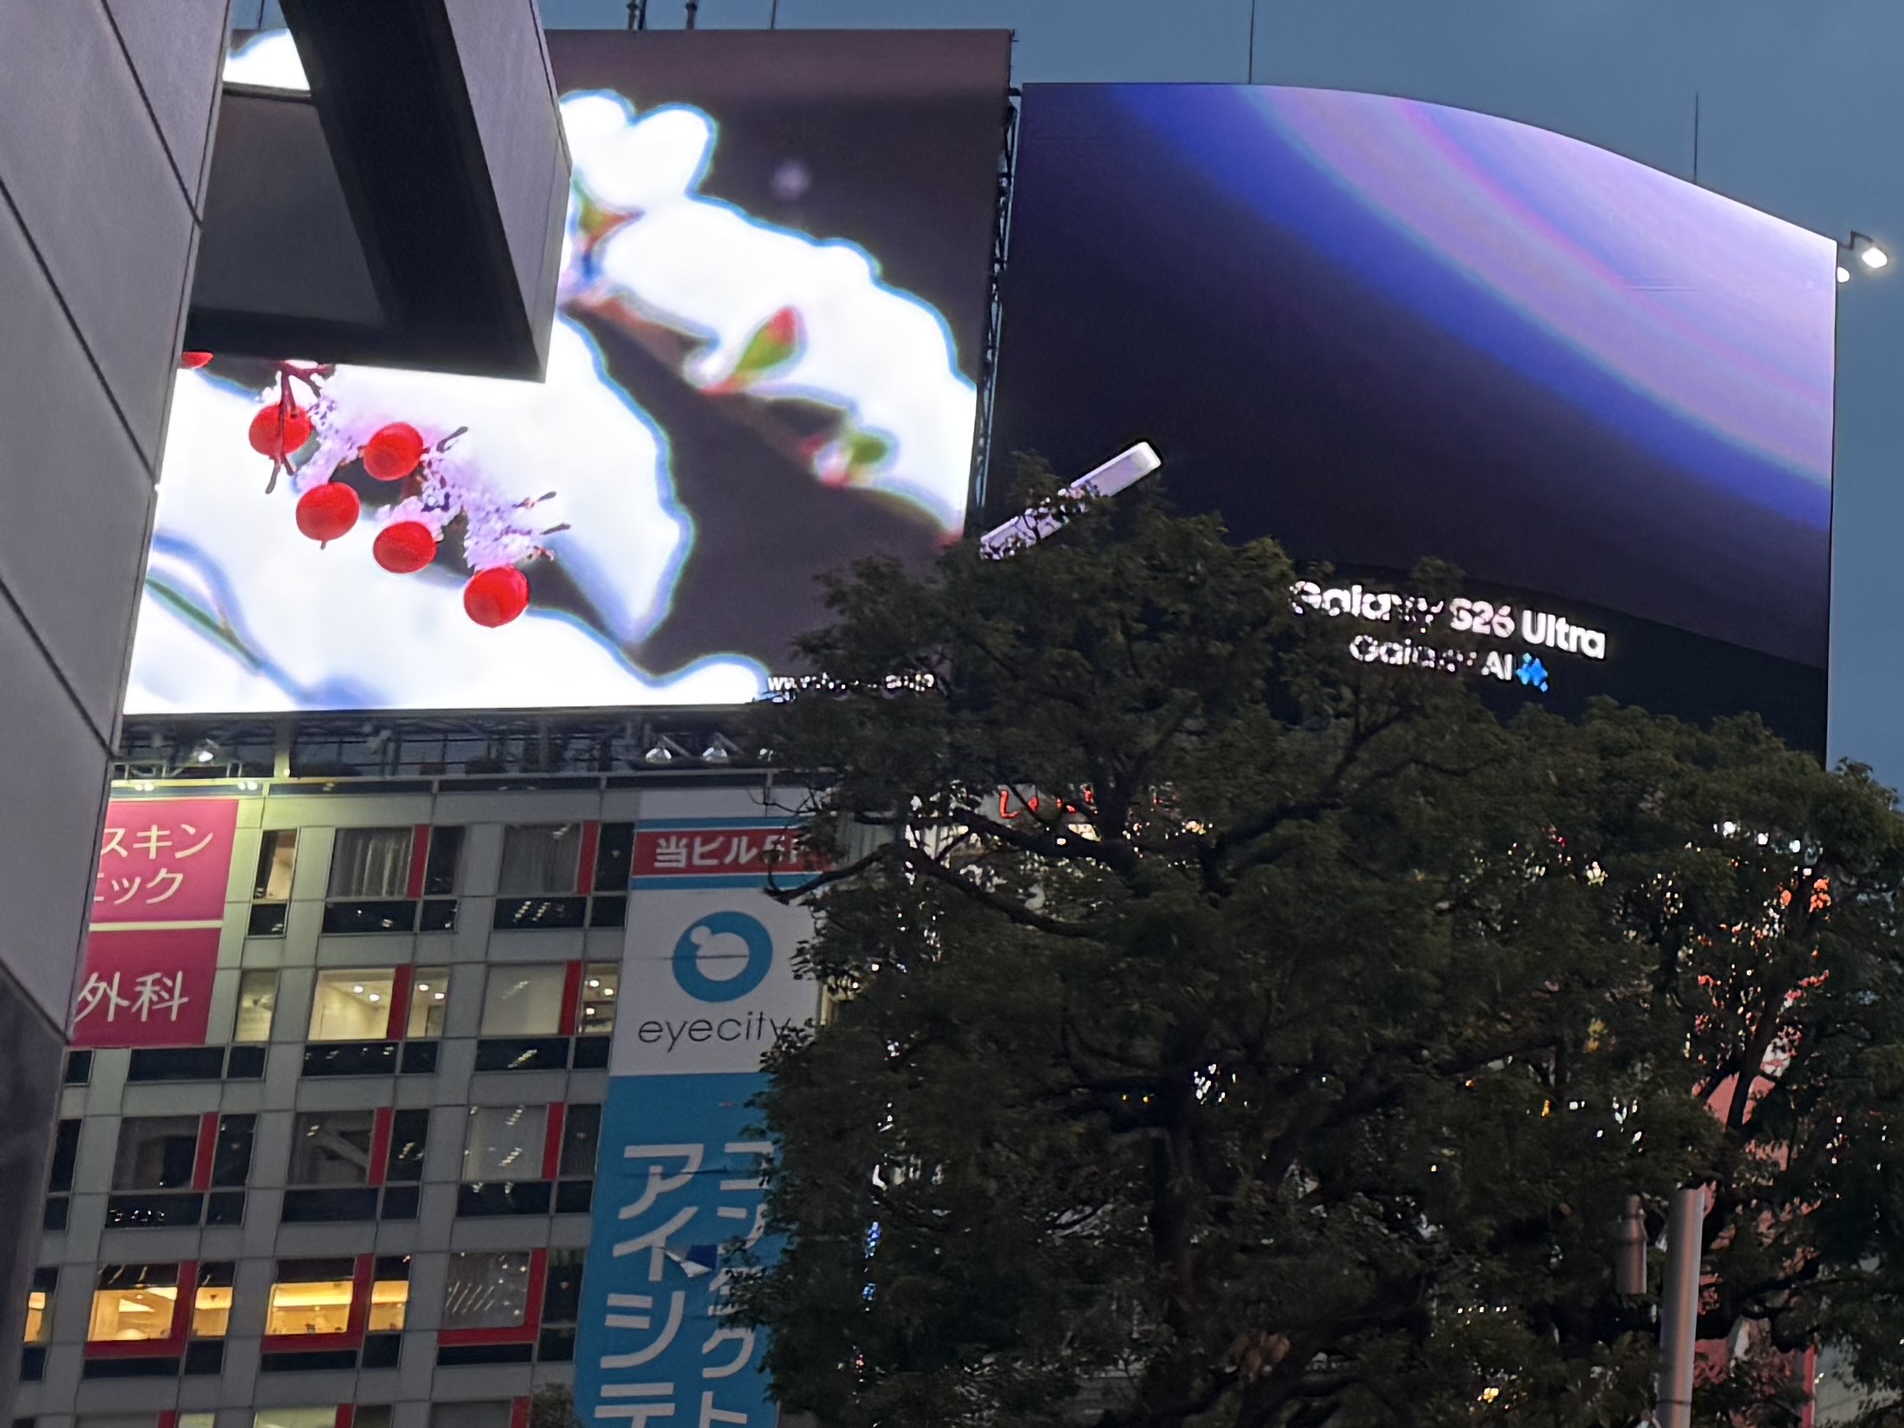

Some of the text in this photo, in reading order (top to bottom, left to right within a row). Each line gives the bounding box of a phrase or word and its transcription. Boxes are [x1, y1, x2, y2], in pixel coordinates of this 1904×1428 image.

[1349, 634, 1477, 673] Gala
[1521, 609, 1606, 660] Ultra
[73, 970, 189, 1023] 外科
[638, 1011, 791, 1053] eyecity
